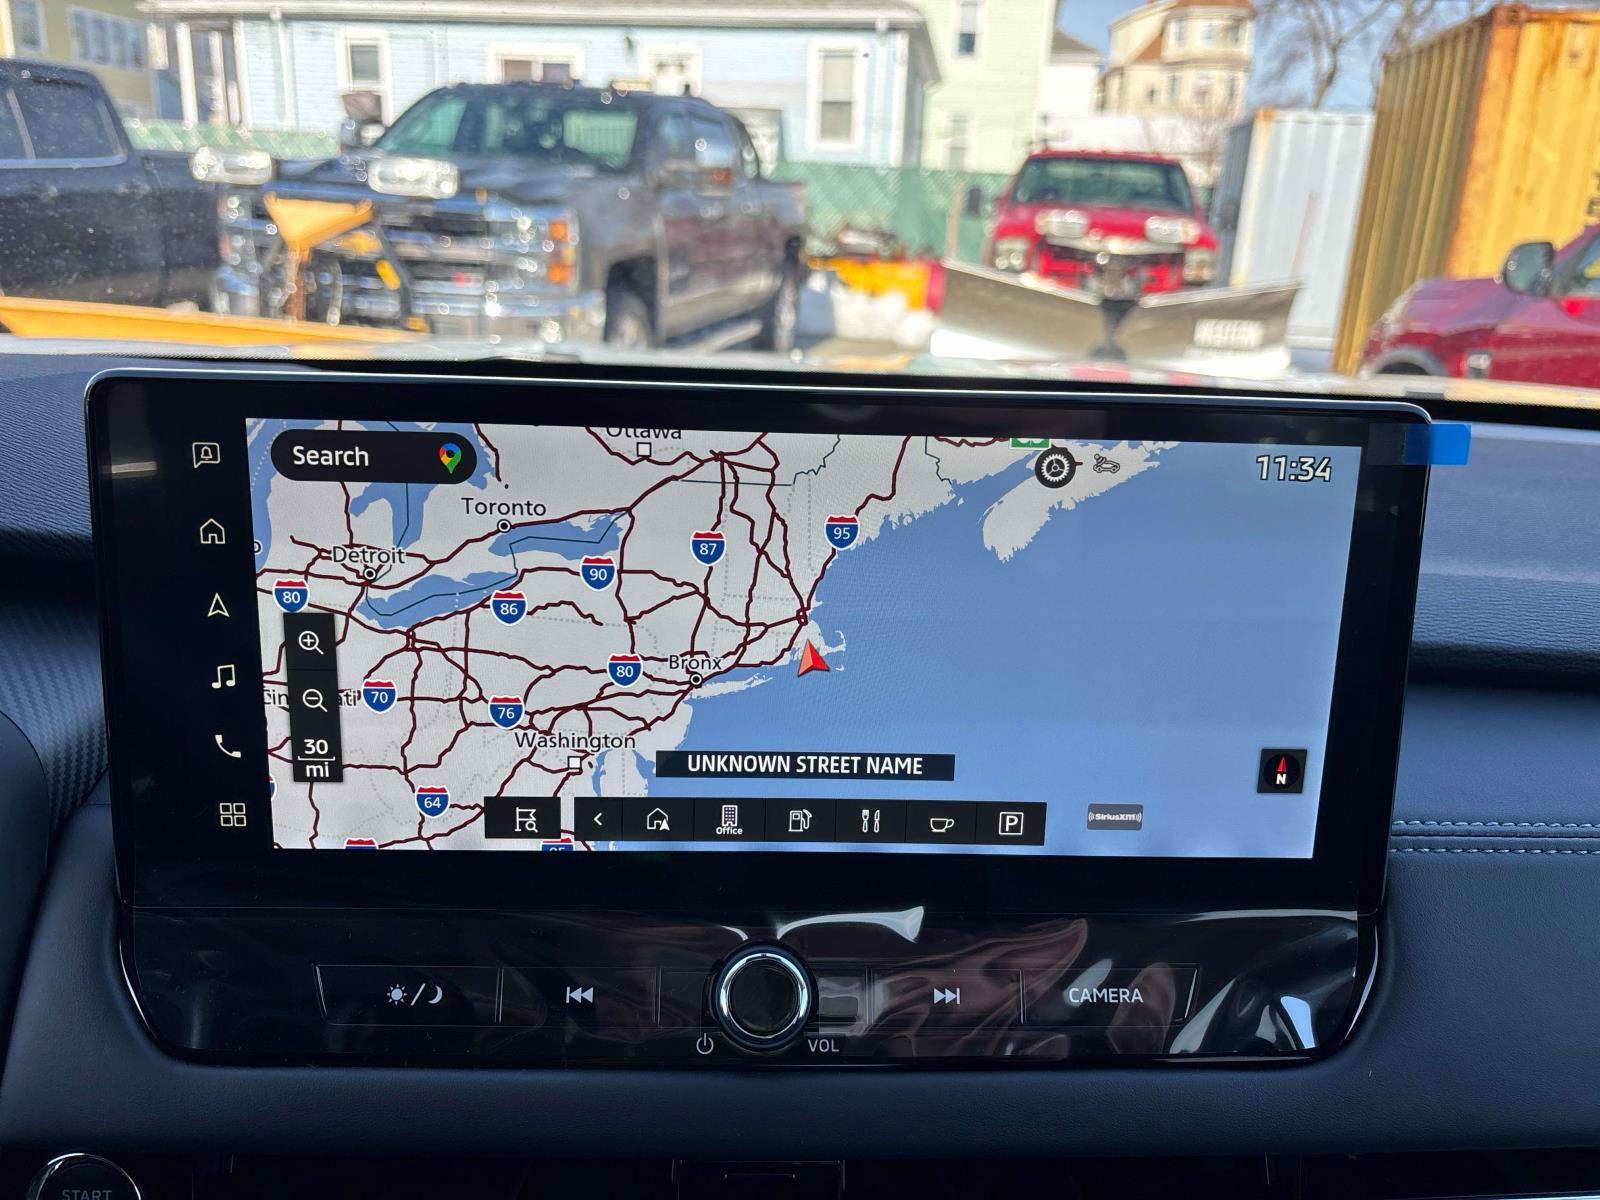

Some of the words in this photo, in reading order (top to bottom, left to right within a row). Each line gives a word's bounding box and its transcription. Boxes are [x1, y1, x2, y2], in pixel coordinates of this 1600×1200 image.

[293, 445, 370, 467] Search
[1257, 455, 1332, 483] 11:34
[461, 497, 547, 516] Toronto
[833, 526, 850, 540] 95
[332, 545, 405, 565] Detroit
[699, 542, 718, 556] 87
[589, 567, 608, 581] 90
[282, 590, 301, 604] 80
[500, 602, 519, 616] 86
[668, 655, 722, 671] Bronx
[615, 665, 634, 678] 80
[371, 691, 389, 704] 70
[497, 706, 515, 719] 76
[304, 739, 329, 755] 30
[514, 731, 636, 753] Washington
[306, 762, 330, 778] mi
[688, 755, 792, 773] UNKNOWN
[796, 756, 862, 774] STREET
[866, 757, 923, 775] NAME
[1275, 773, 1287, 785] N
[424, 796, 442, 809] 64
[1005, 814, 1018, 832] P
[715, 825, 744, 836] Office
[1068, 987, 1144, 1004] CAMERA
[807, 1038, 840, 1053] VOL
[61, 1189, 113, 1200] START
